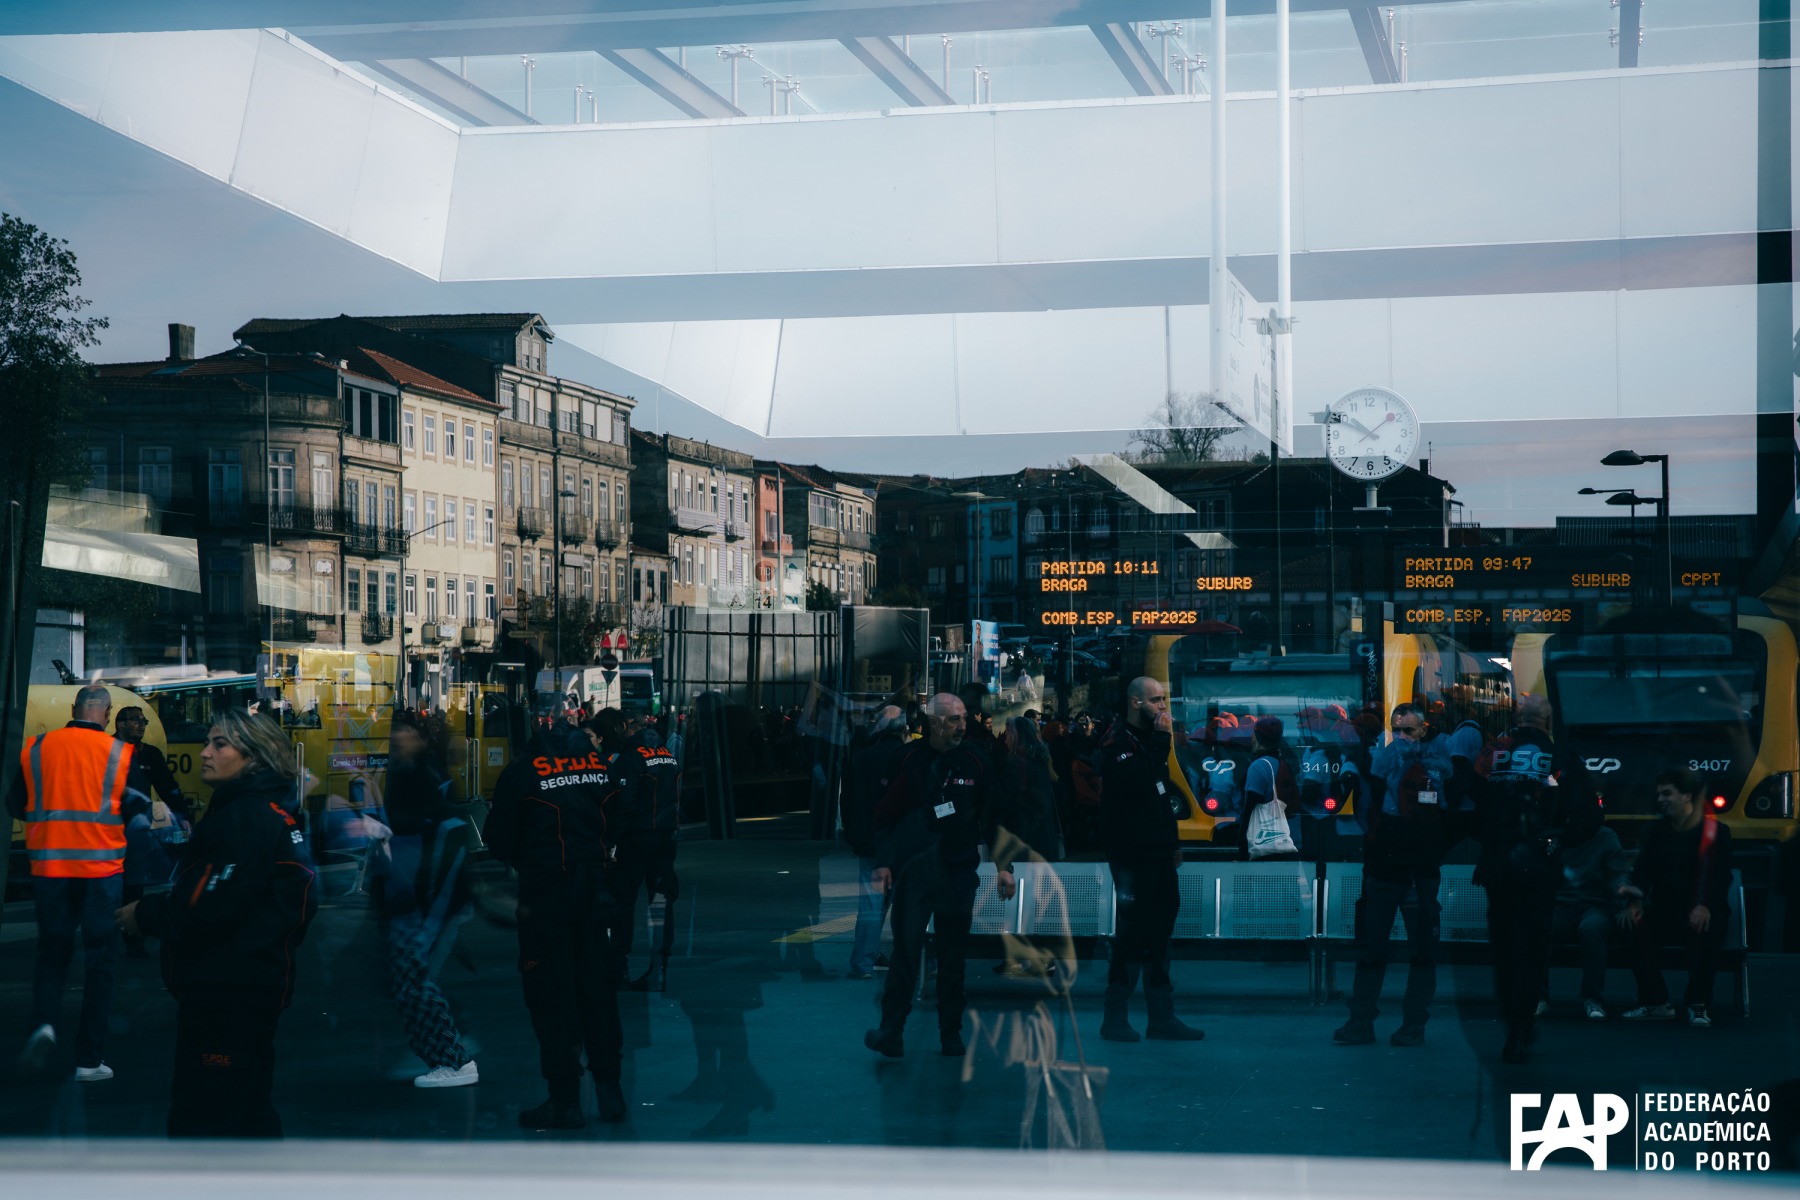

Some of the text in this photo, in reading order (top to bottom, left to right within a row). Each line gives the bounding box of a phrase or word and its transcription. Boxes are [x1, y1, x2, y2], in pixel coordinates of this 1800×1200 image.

[1350, 402, 1358, 413] 11
[1364, 397, 1375, 408] 12
[1384, 402, 1388, 412] 1
[1395, 413, 1402, 423] 2
[1332, 430, 1340, 440] 9
[1400, 428, 1408, 438] 3
[1338, 445, 1346, 456] 8
[1394, 444, 1402, 454] 4
[1351, 456, 1359, 467] 7
[1366, 460, 1374, 471] 6
[1383, 455, 1391, 466] 5
[1041, 560, 1159, 575] PARTIDA 10:11
[1405, 556, 1533, 571] PARTIDA 09:47
[1041, 576, 1253, 592] BRAGA SUBURB
[1405, 572, 1721, 588] BRAGA SUBURB CPPT
[1041, 611, 1198, 625] COMB.ESP. FAP2026
[1502, 608, 1572, 623] FAP2026
[1492, 749, 1553, 773] PSG
[1688, 759, 1732, 772] 3407
[1302, 761, 1340, 774] 3410
[540, 773, 610, 790] SEGURANÇA
